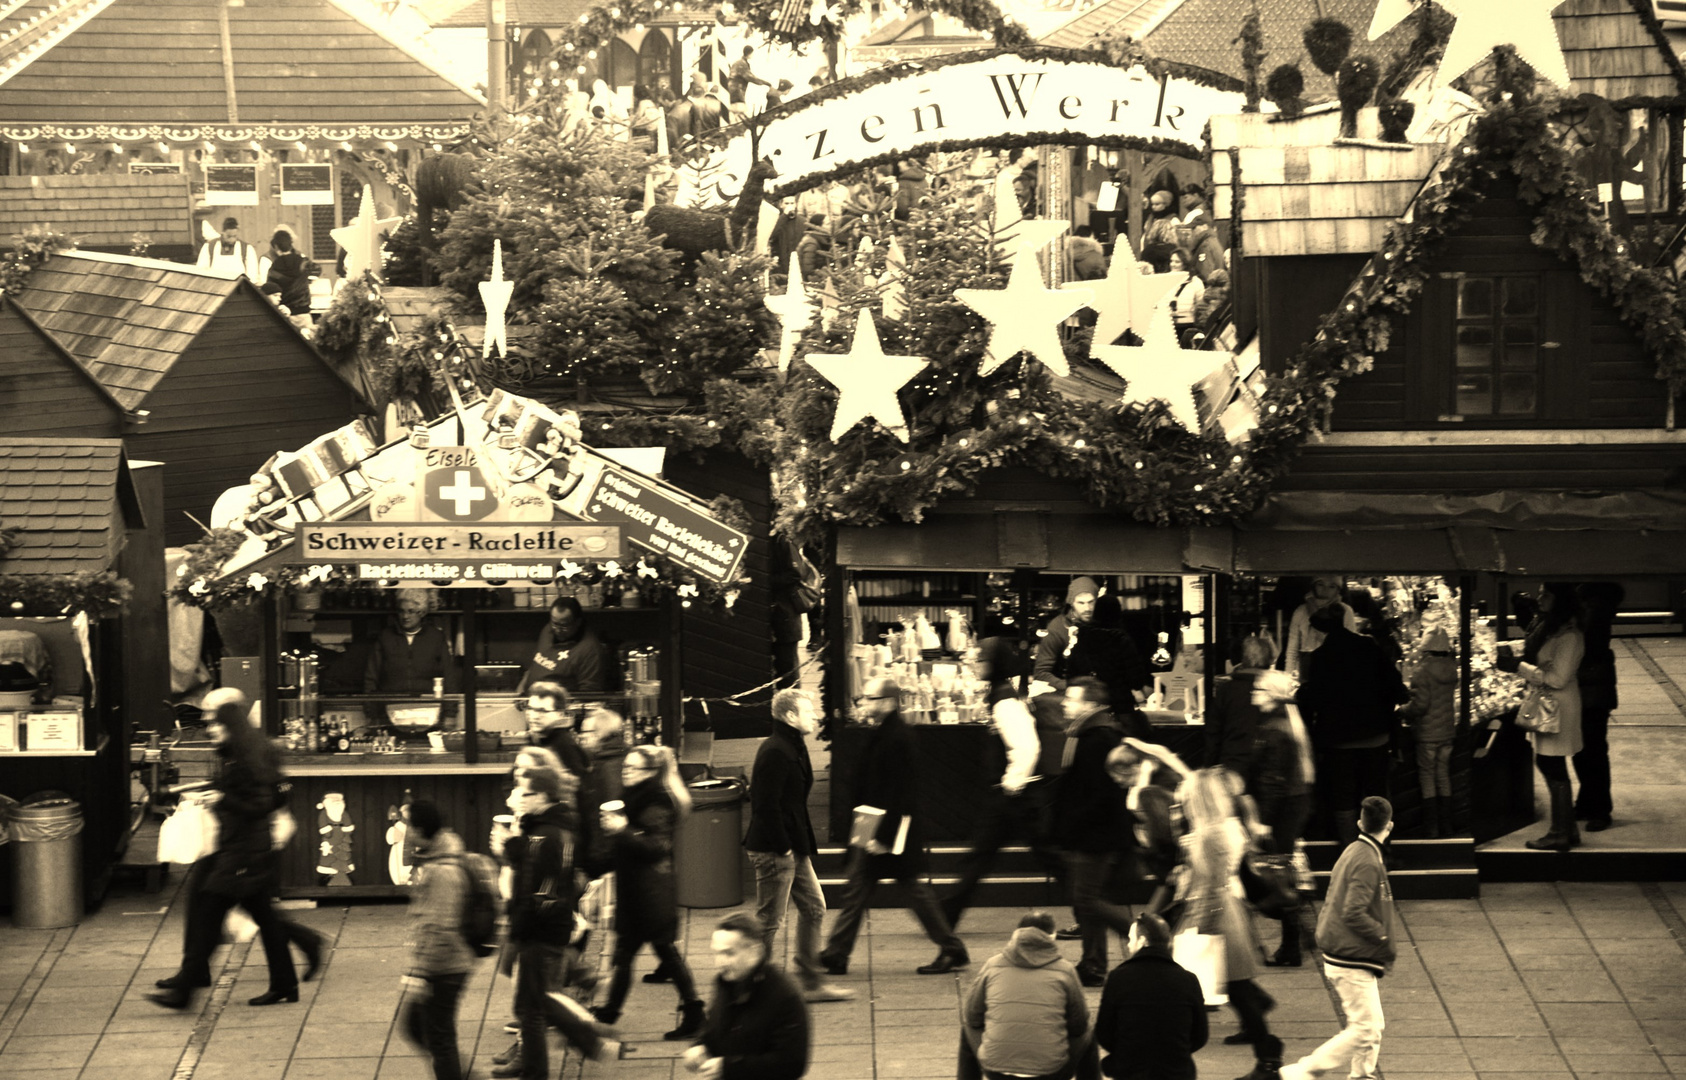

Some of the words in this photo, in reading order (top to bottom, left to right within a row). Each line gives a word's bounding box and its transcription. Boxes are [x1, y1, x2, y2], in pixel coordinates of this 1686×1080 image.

[984, 72, 1186, 132] Werk
[307, 531, 447, 552] Schweizer
[468, 530, 574, 552] Raclette
[596, 486, 659, 526] Schweizer
[655, 516, 735, 565] Raclettekäse
[359, 563, 460, 579] Raclettekäse
[464, 565, 477, 579] &
[480, 563, 553, 579] Glühwein
